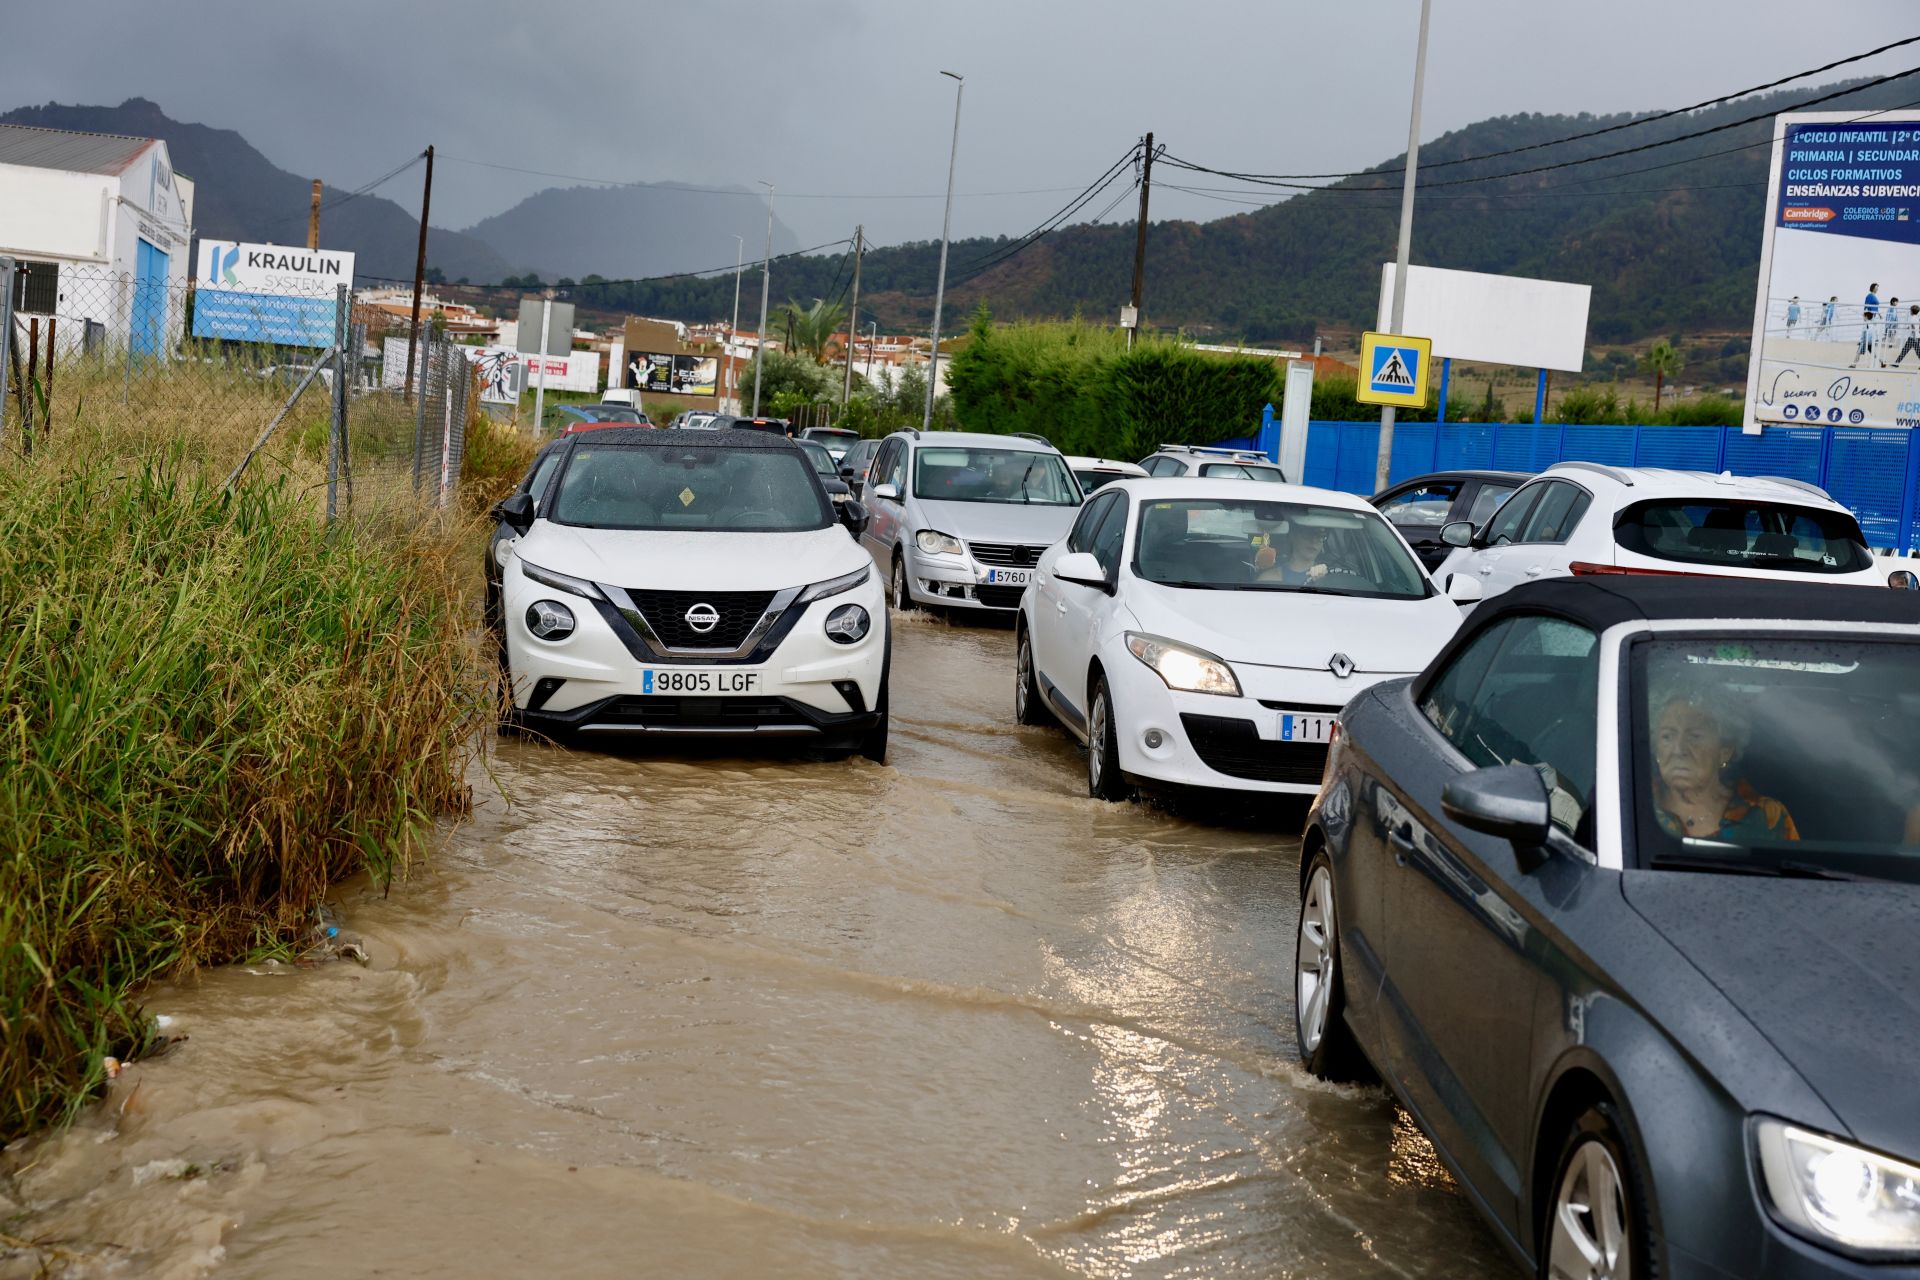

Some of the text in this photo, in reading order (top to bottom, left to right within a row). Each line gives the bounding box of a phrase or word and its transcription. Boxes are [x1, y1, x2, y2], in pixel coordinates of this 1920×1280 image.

[1839, 131, 1888, 143] INFANTIL
[1790, 150, 1845, 162] PRIMARIA
[1788, 169, 1902, 181] CICLOS FORMATIVOS
[1786, 183, 1860, 197] ENSEÑANZAS
[1786, 209, 1829, 220] Cambridge
[248, 252, 341, 275] KRAULIN
[265, 274, 325, 291] SYSTEM
[997, 571, 1026, 583] 5760
[657, 673, 711, 692] 9805
[718, 673, 758, 692] LGF
